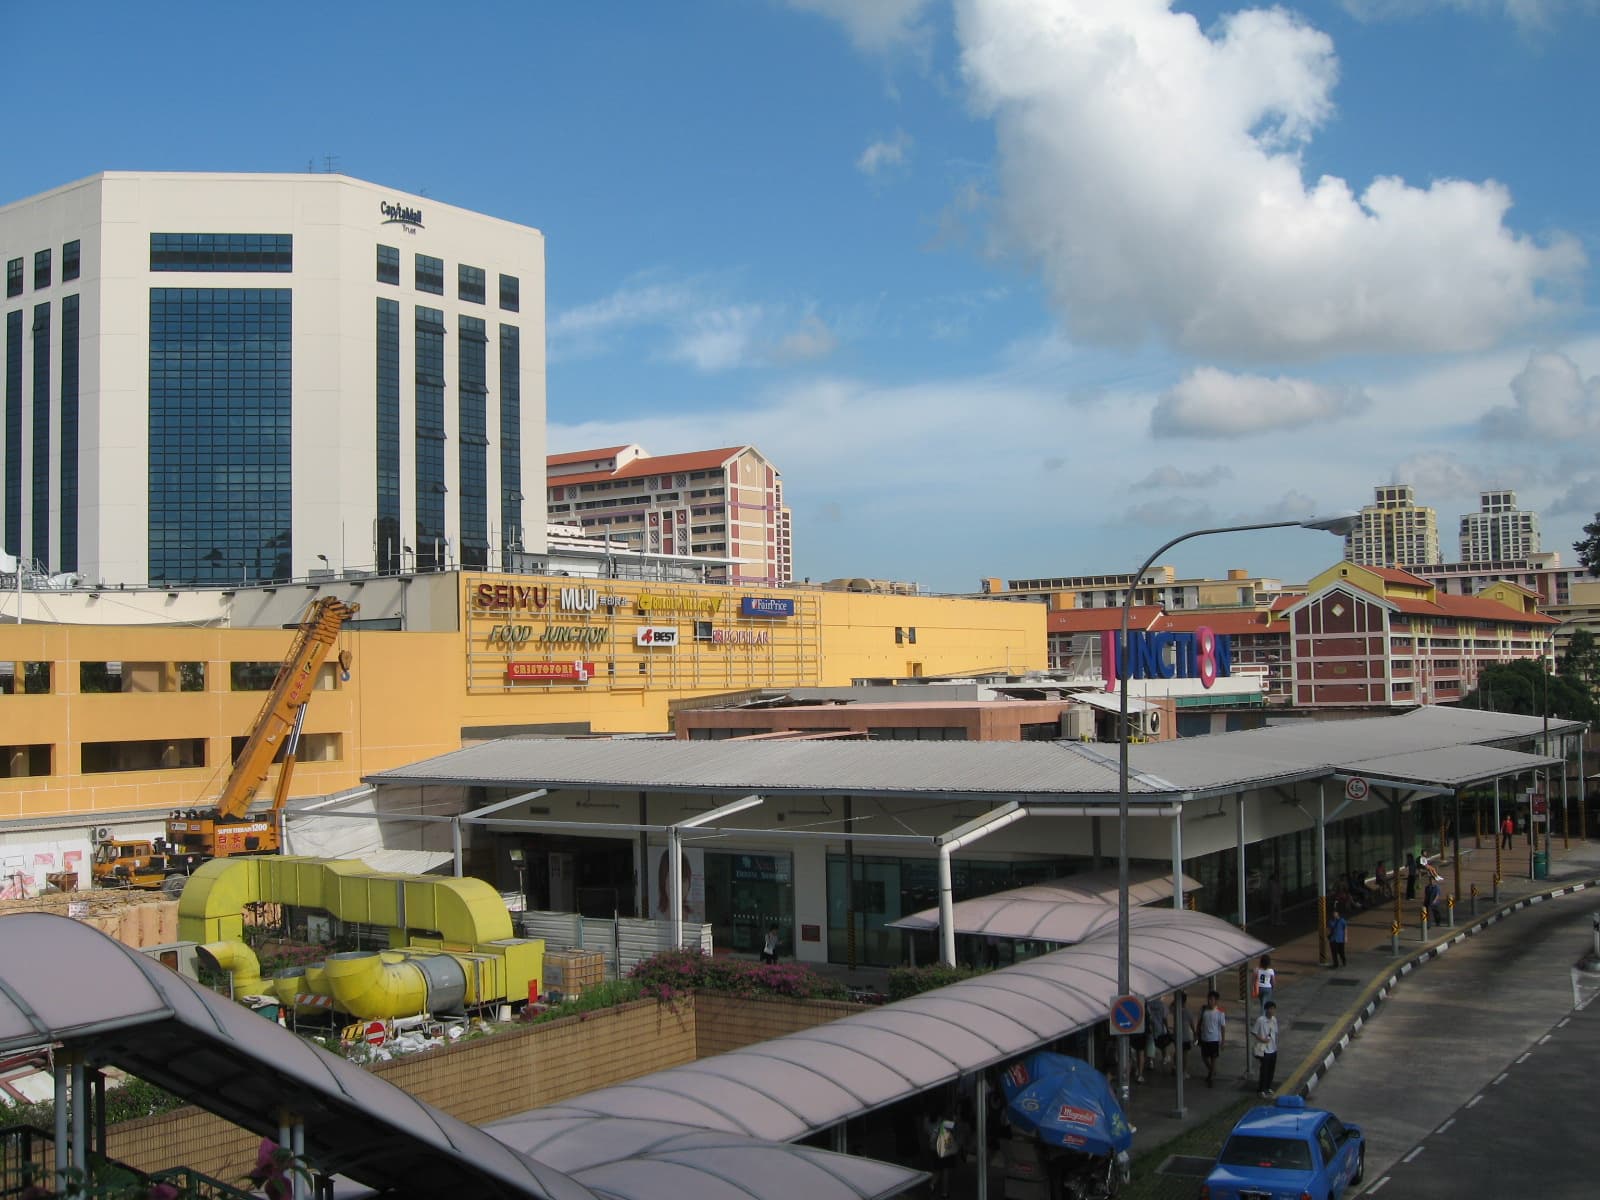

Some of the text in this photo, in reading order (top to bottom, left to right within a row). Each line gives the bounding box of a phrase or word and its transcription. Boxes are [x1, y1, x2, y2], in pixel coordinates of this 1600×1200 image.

[478, 584, 548, 608] SEIYU
[561, 588, 597, 610] MUJI
[758, 599, 788, 611] FairPrice
[490, 624, 609, 644] FOOD JUNCTION
[653, 631, 676, 641] BEST
[722, 629, 769, 645] POPULAR
[513, 664, 573, 674] CRISTOFORI
